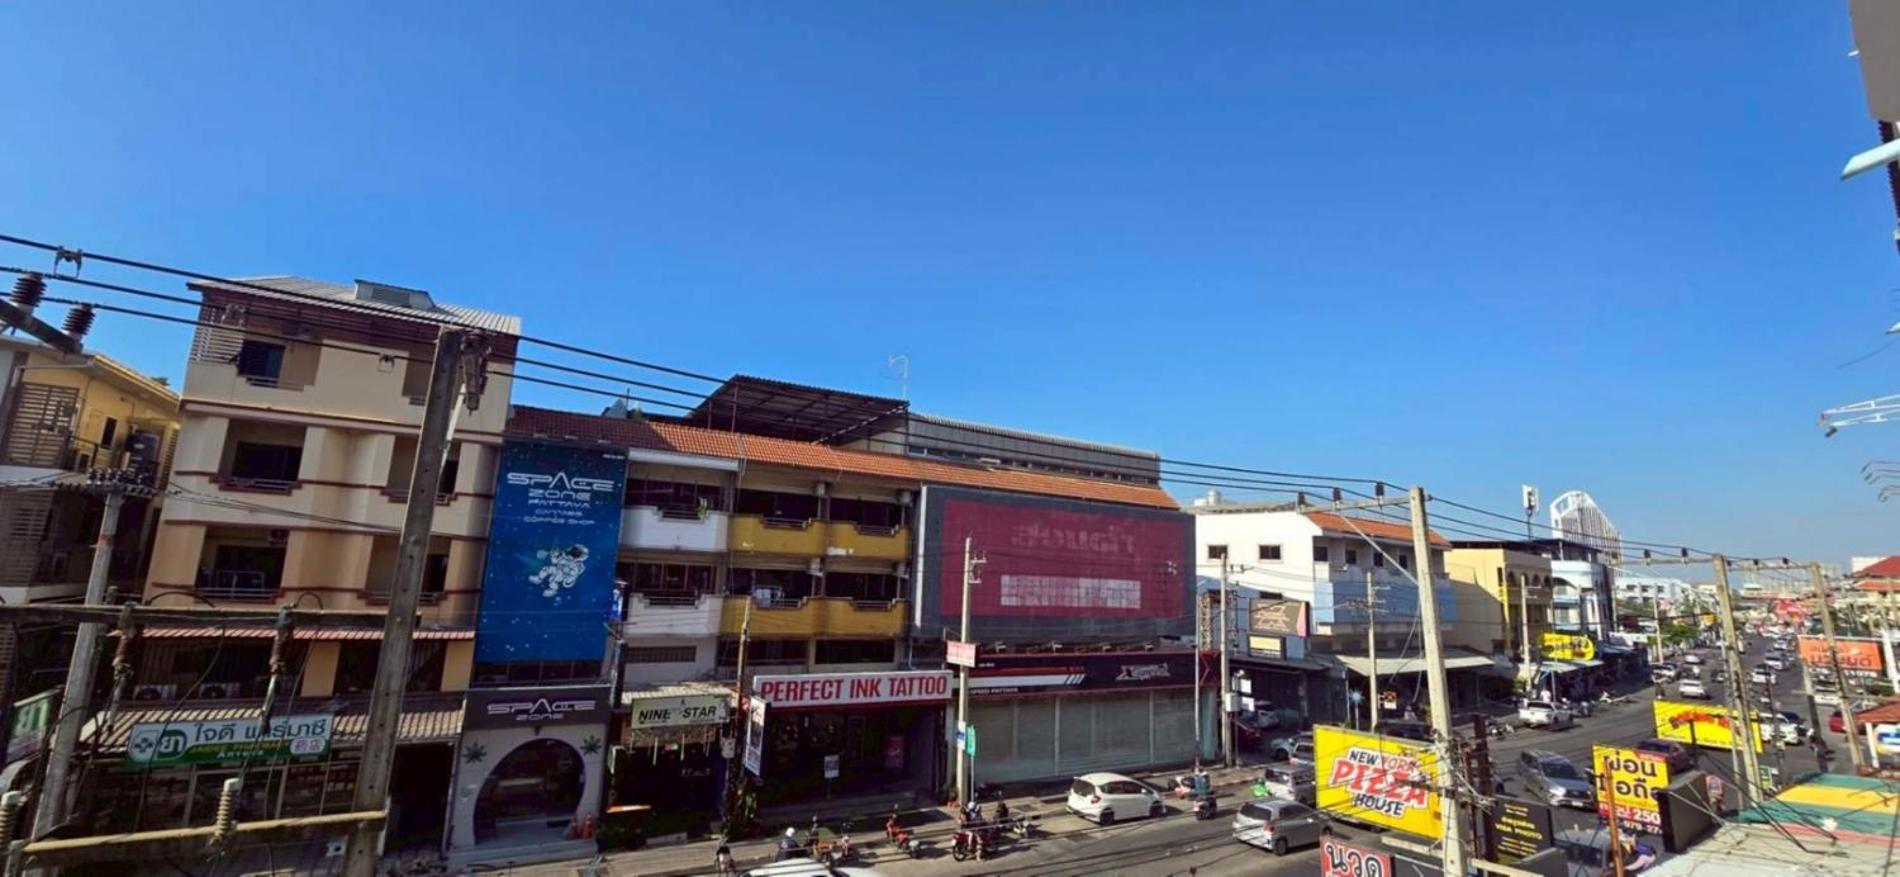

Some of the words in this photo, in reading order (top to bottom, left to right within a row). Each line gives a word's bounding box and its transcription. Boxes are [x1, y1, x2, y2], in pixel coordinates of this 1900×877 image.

[507, 471, 615, 492] SPACE
[528, 488, 592, 501] ZONE
[760, 679, 845, 702] PERFECT
[850, 677, 883, 699] INK
[887, 675, 947, 697] TATTOO
[487, 698, 596, 714] SPACE
[638, 708, 672, 721] NINE
[682, 705, 717, 719] STAR
[194, 723, 236, 742] ใจดี
[1349, 749, 1379, 766] NEW
[1331, 759, 1427, 805] PIZZA
[1353, 793, 1405, 816] HOUSE
[1633, 809, 1661, 827] 250
